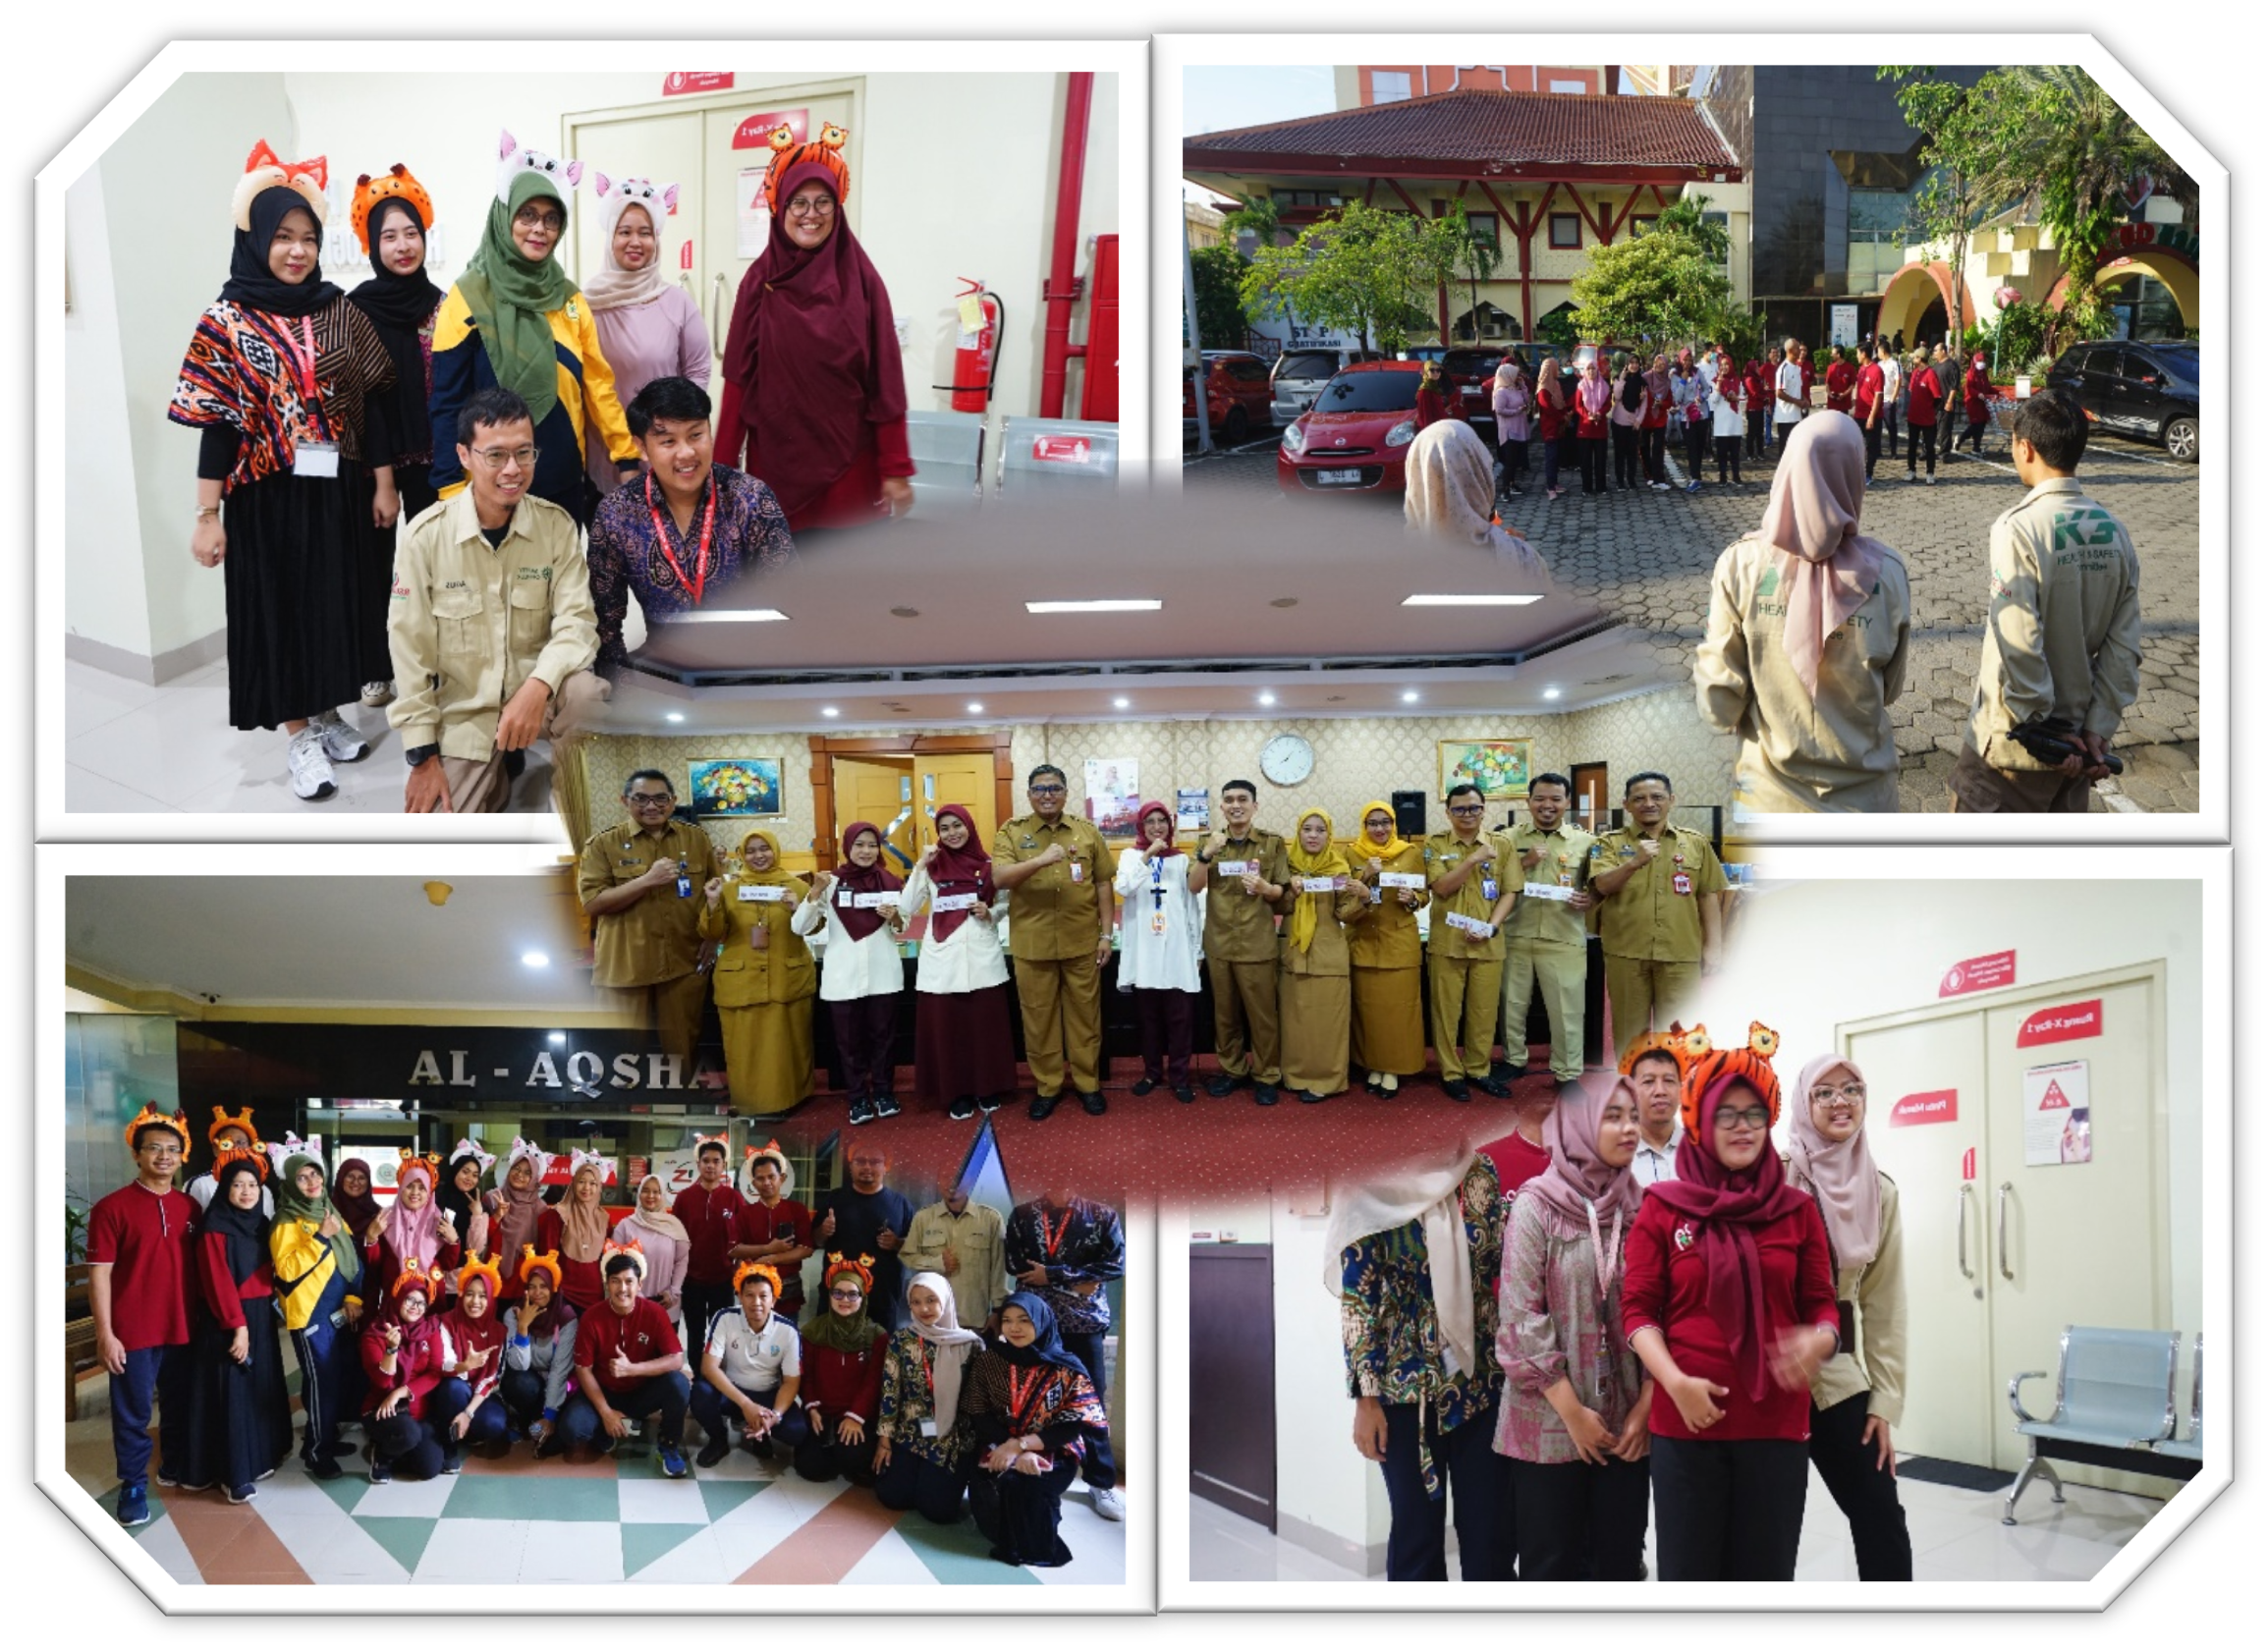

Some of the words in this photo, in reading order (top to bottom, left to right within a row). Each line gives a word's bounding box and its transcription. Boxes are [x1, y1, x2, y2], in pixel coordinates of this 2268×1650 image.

[2054, 509, 2118, 551] K3
[408, 1049, 476, 1087] AL
[526, 1051, 724, 1099] AQSHA
